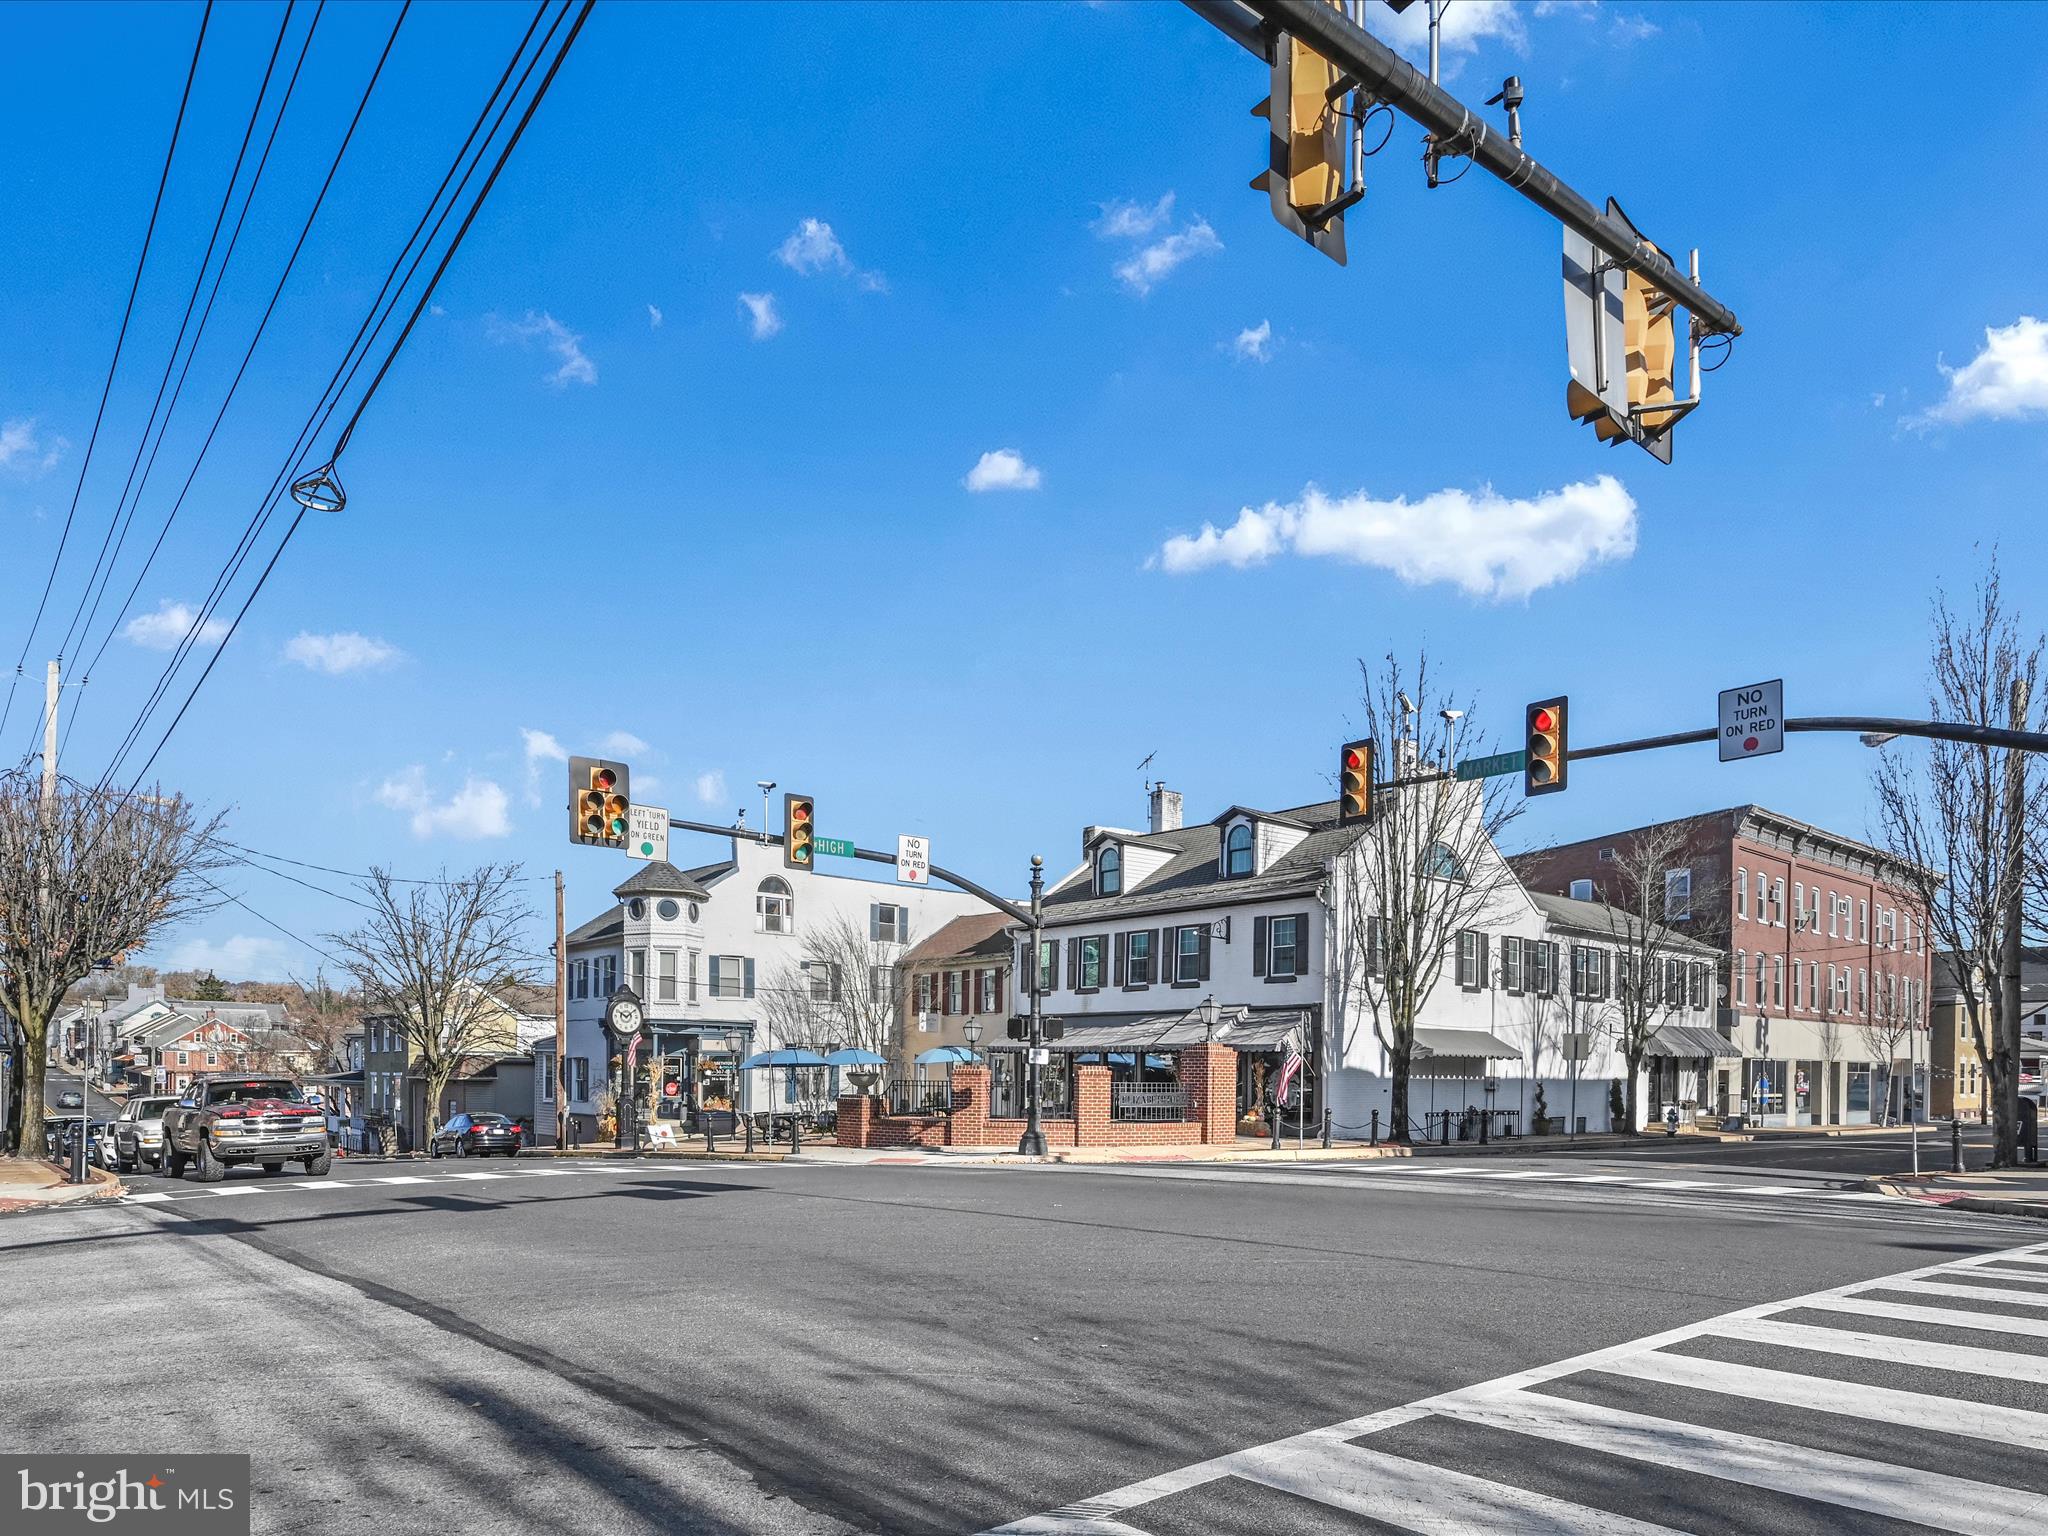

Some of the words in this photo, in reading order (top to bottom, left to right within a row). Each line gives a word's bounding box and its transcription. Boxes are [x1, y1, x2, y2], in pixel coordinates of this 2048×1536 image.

[1737, 689, 1763, 707] NO
[1733, 705, 1768, 721] TURN
[1726, 724, 1743, 737] ON
[1750, 718, 1775, 733] RED
[1463, 753, 1519, 778] MARKET
[630, 809, 646, 818] LEFT
[649, 811, 666, 820] TURN
[636, 820, 660, 831] YIELD
[630, 830, 640, 839] ON
[643, 832, 665, 842] GREEN
[818, 839, 845, 855] HIGH
[907, 839, 921, 849] NO
[905, 849, 923, 859] TURN
[900, 858, 910, 867] ON
[912, 860, 926, 869] RED
